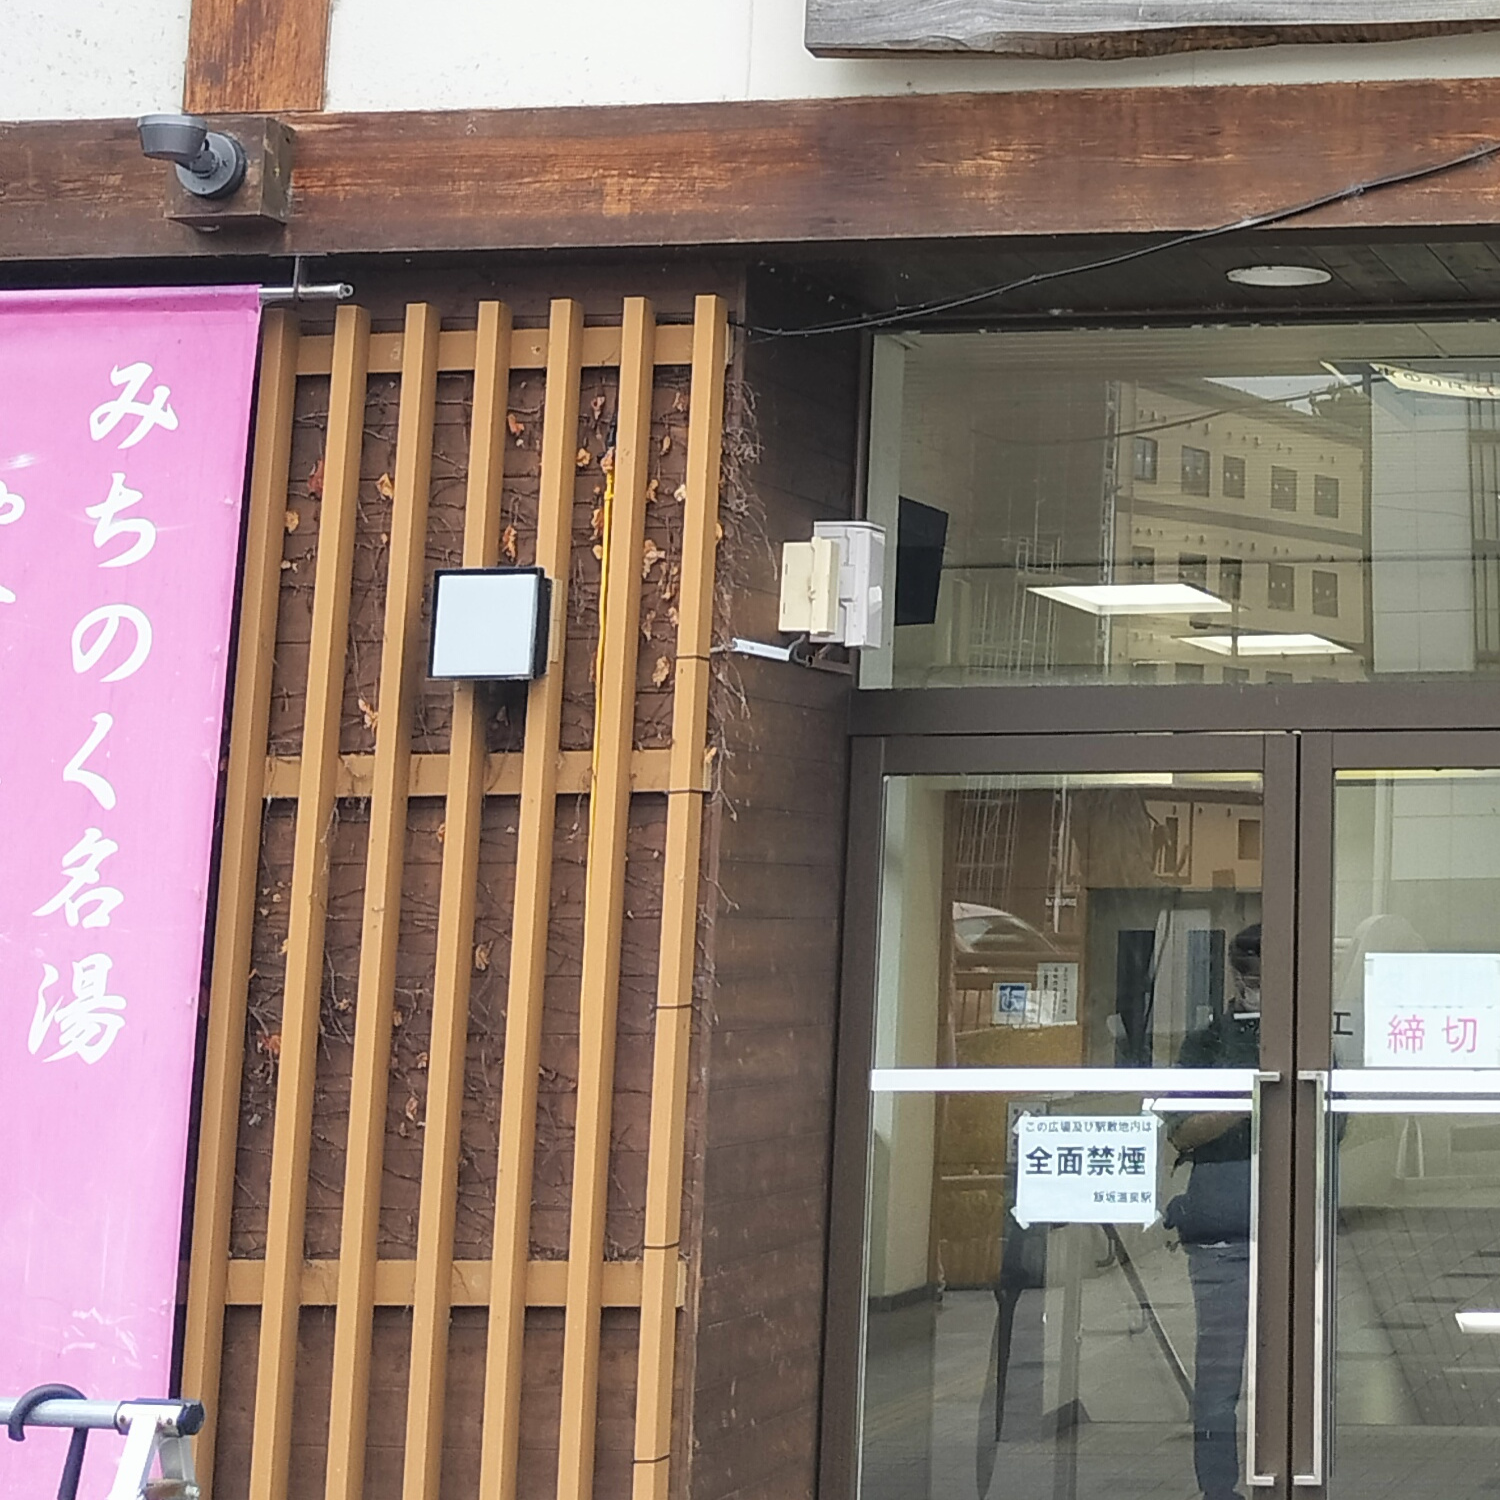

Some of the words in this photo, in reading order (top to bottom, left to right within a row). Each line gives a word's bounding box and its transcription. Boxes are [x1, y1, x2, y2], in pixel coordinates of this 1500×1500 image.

[27, 361, 179, 1065] みちのく名湯
[1387, 1013, 1478, 1055] 締切
[1025, 1145, 1147, 1177] 全面禁煙
